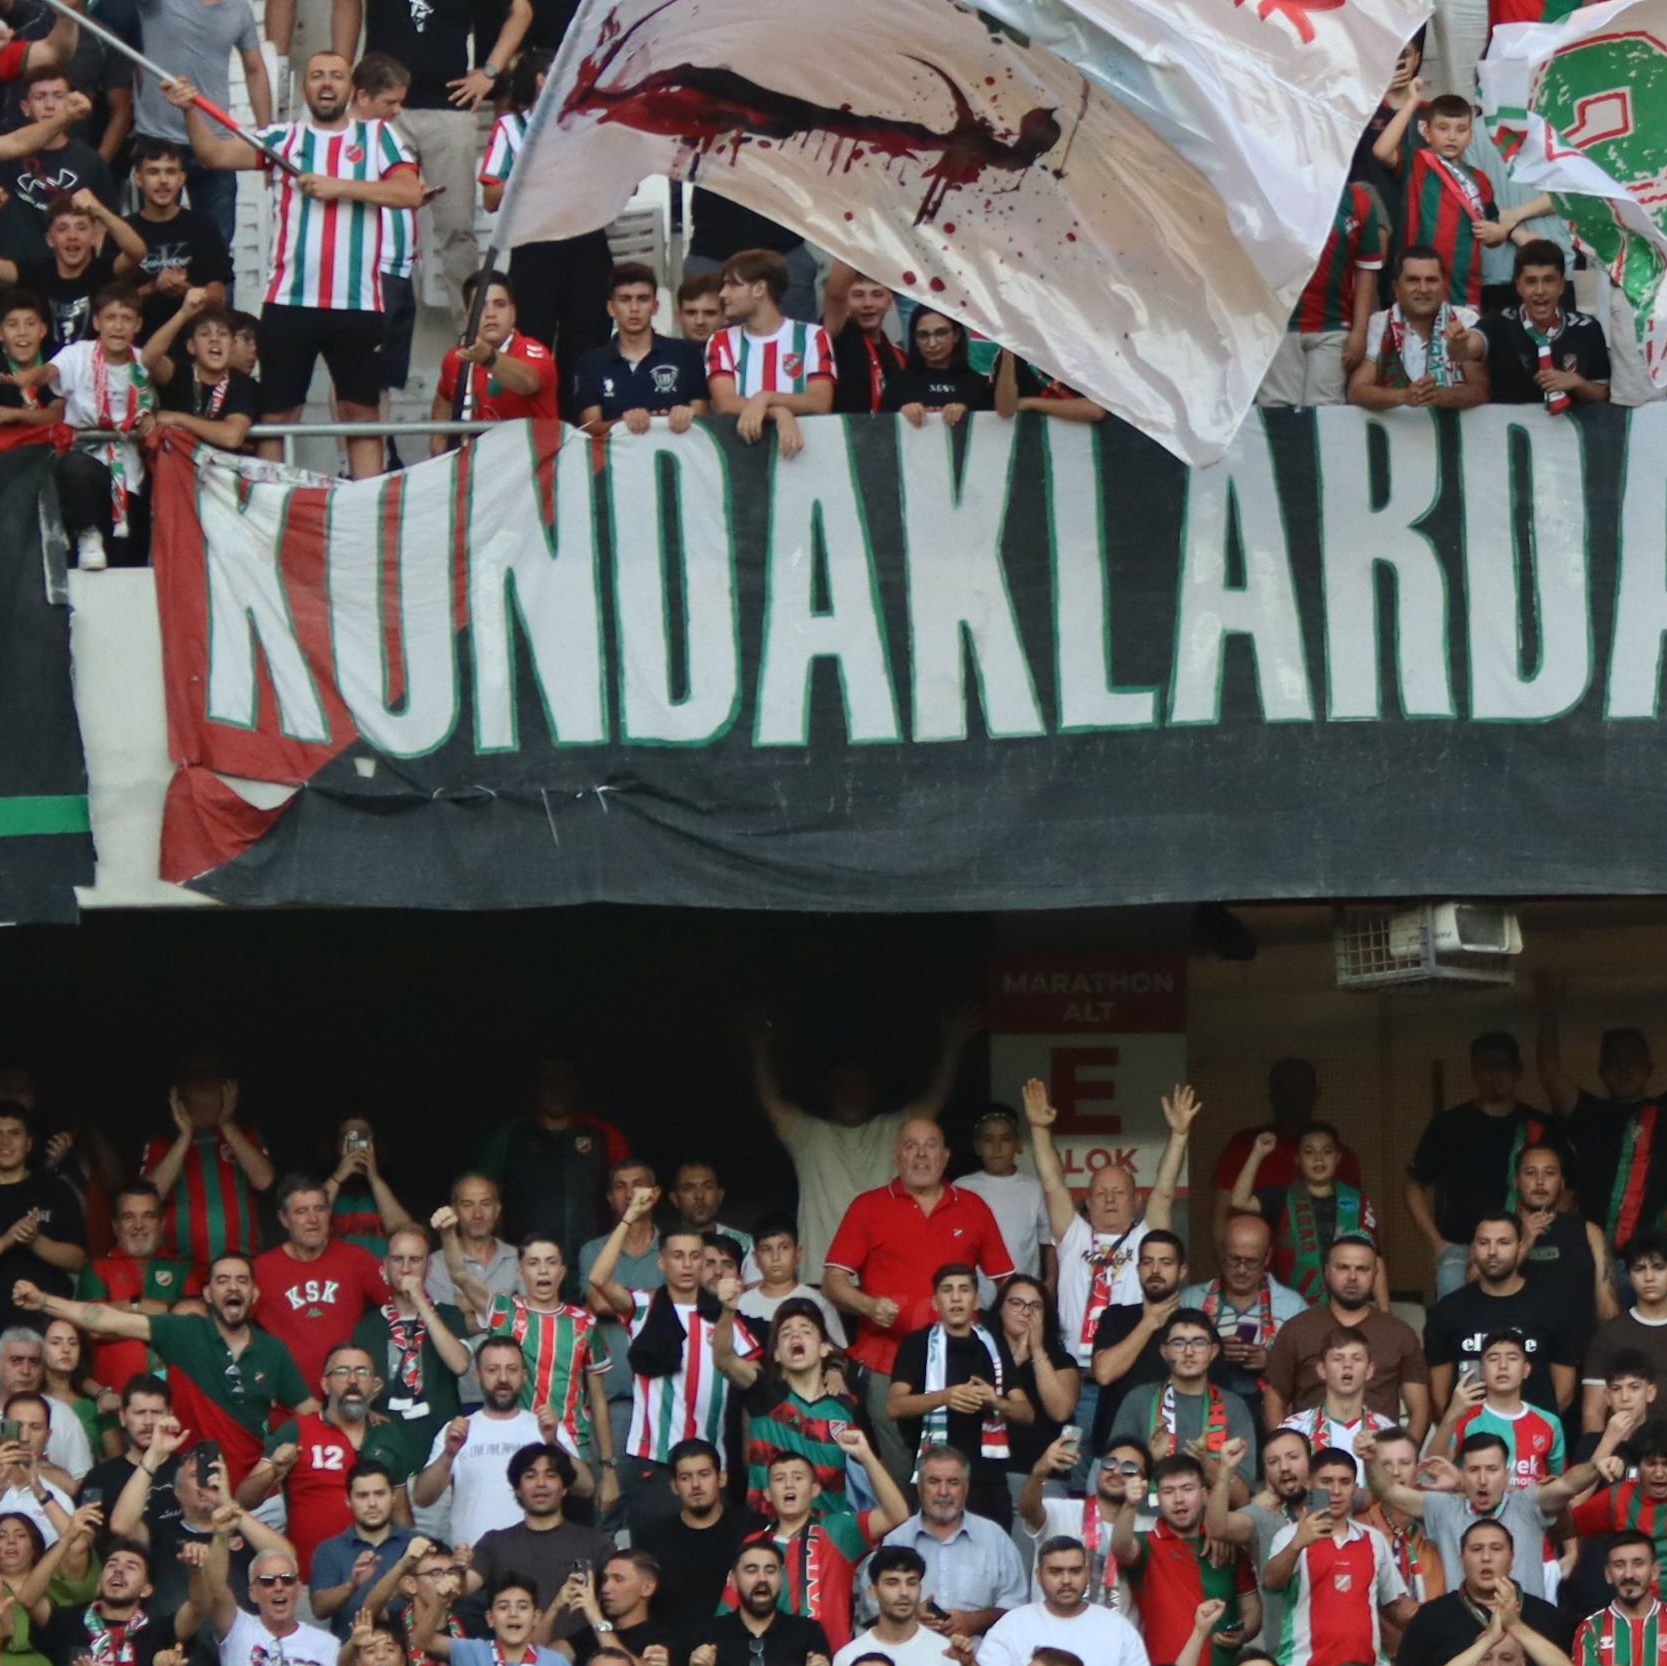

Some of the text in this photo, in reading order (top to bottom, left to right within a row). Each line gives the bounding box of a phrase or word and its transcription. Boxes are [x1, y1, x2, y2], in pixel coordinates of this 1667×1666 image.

[1003, 972, 1174, 994] MARATHON
[1063, 1001, 1115, 1023] ALT
[1048, 1047, 1122, 1136] E
[1061, 1148, 1138, 1174] LOK
[285, 1279, 339, 1310] KSK
[310, 1444, 342, 1470] 12
